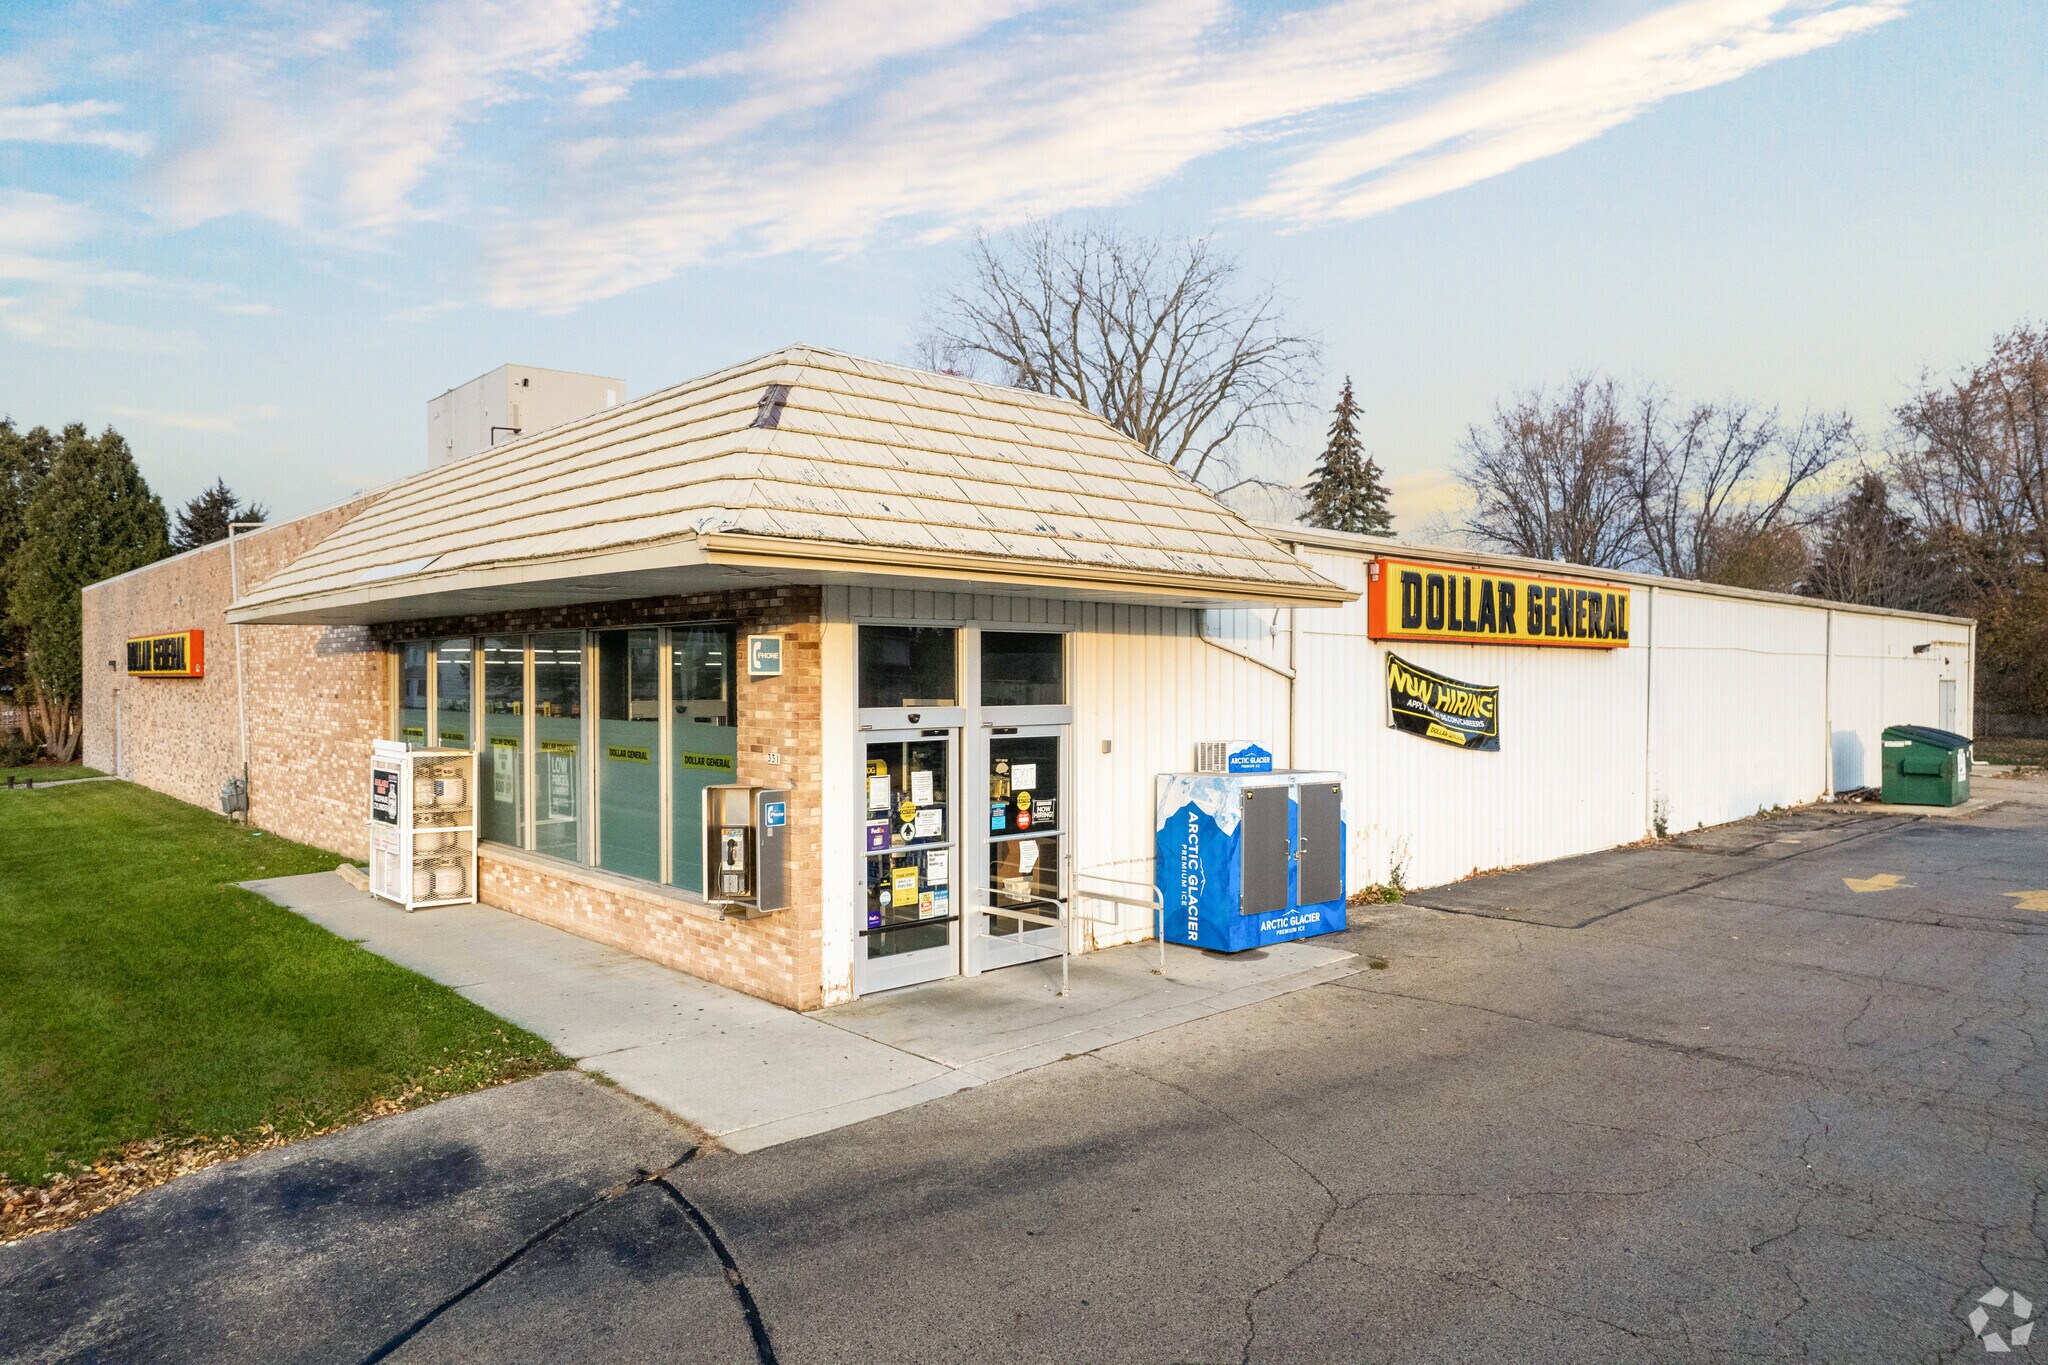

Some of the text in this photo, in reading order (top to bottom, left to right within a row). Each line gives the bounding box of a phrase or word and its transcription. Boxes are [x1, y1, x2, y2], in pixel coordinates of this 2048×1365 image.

[1401, 570, 1629, 640] DOLLAR GENERAL
[1407, 699, 1428, 711] APPLY
[1435, 685, 1494, 718] HIRING
[609, 748, 648, 760] DOLLAR GENERAL
[684, 755, 731, 768] DOLLAR GENERAL
[767, 753, 779, 763] 331
[551, 756, 568, 774] LOW
[1188, 811, 1199, 941] ARCTIC GLACIER
[1261, 912, 1320, 931] ARCTIC GLACIER
[1276, 927, 1297, 935] PREMIUM
